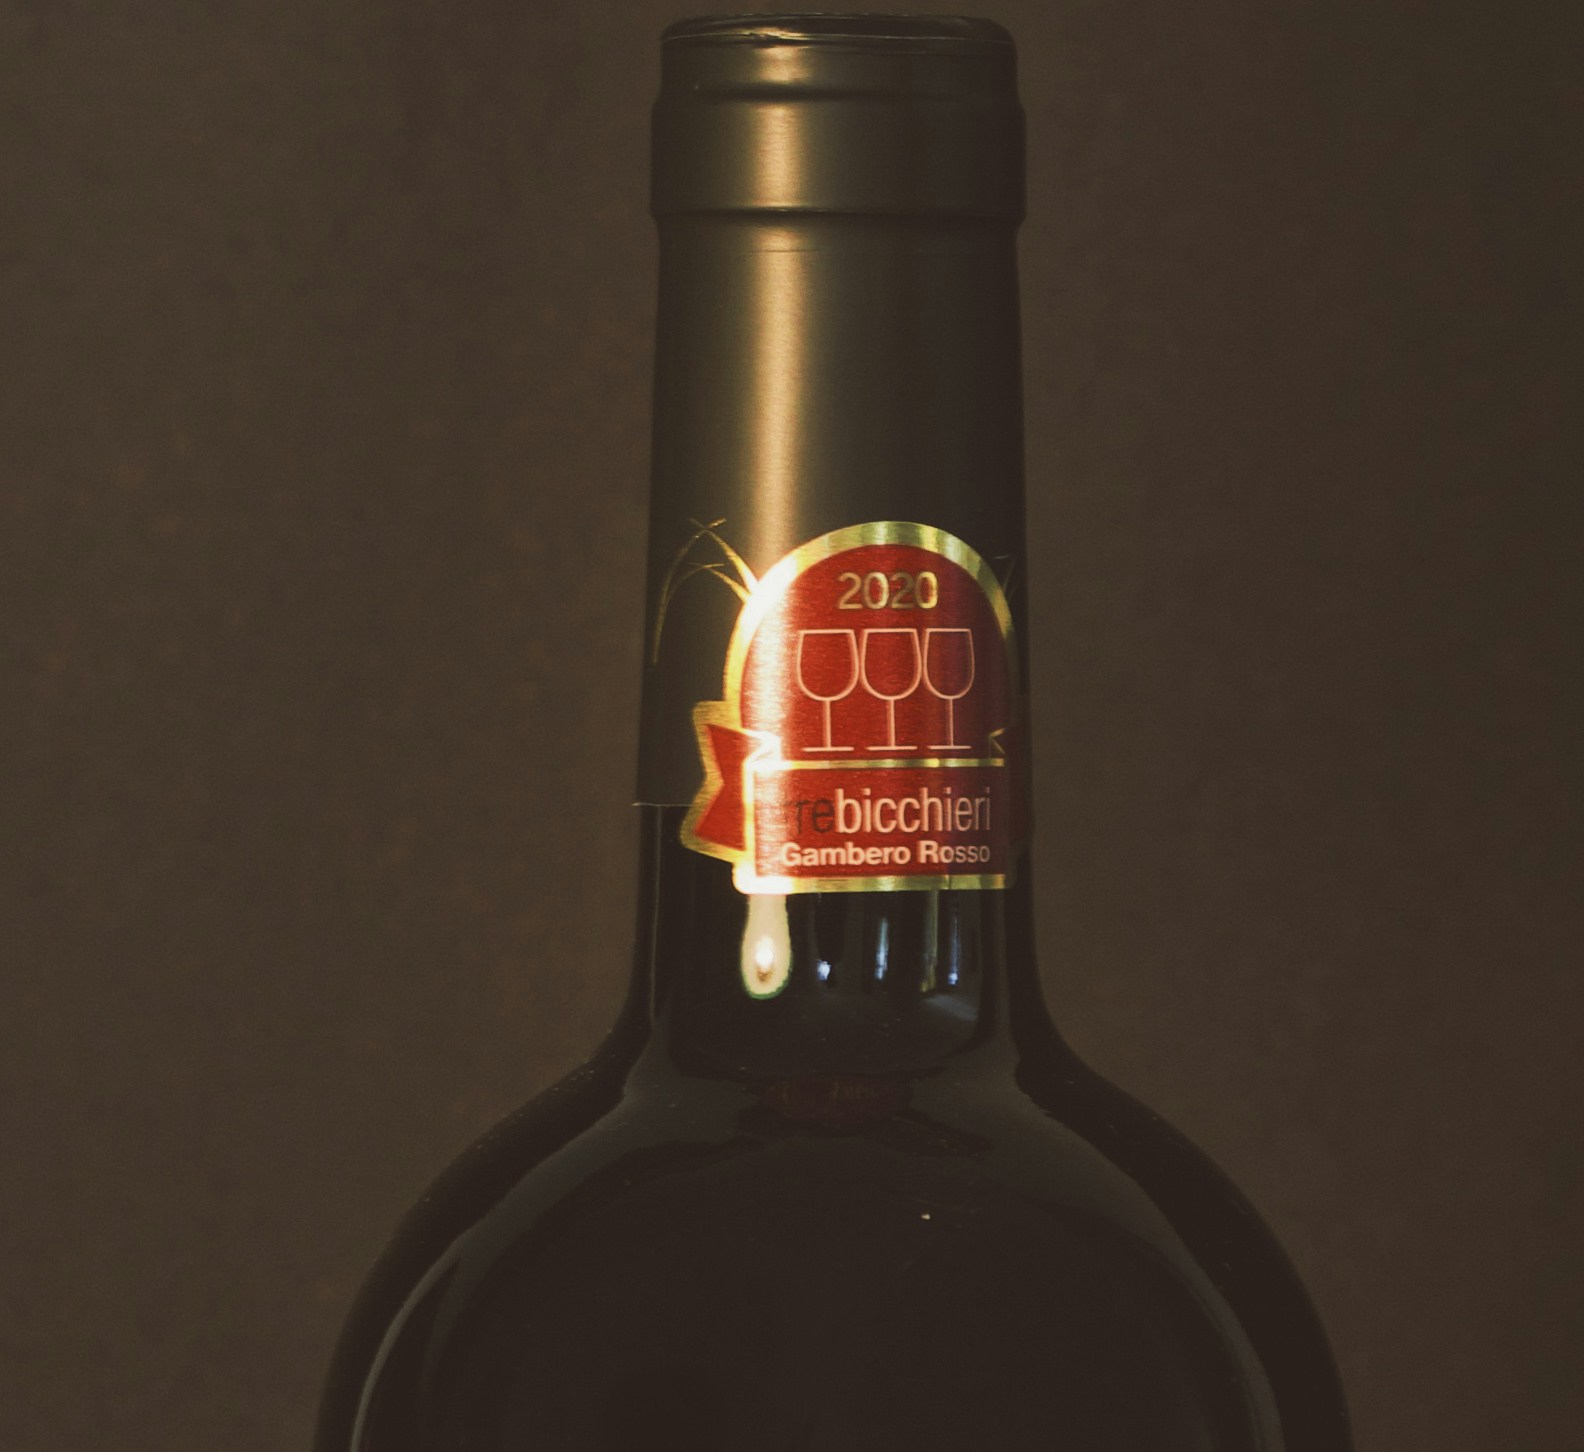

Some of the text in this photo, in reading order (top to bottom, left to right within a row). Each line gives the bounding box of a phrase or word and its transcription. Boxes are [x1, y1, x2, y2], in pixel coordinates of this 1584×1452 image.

[837, 571, 938, 611] 2020
[783, 786, 990, 834] rebicchieri
[781, 839, 990, 867] Gambero Rosso
